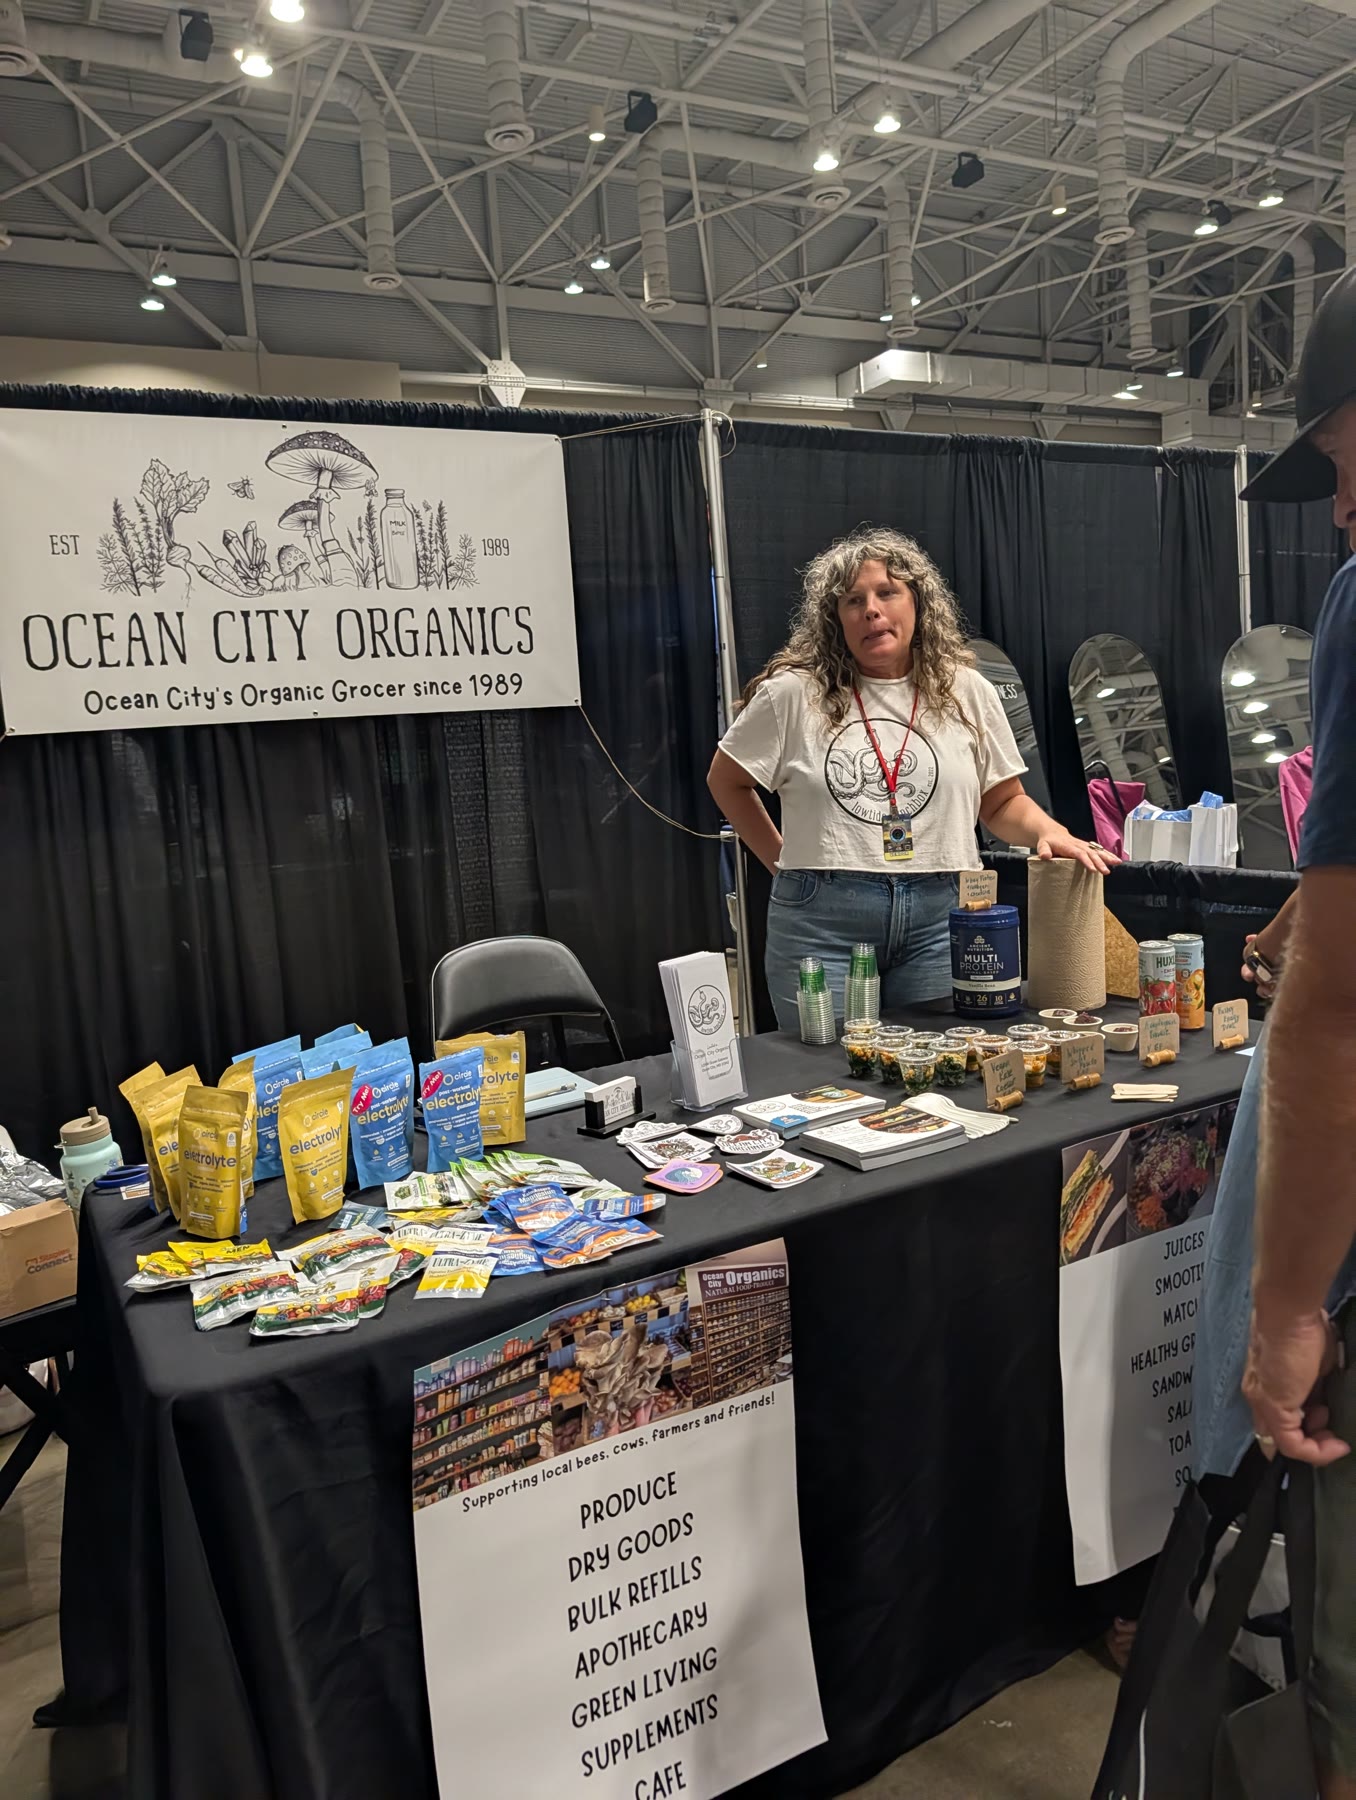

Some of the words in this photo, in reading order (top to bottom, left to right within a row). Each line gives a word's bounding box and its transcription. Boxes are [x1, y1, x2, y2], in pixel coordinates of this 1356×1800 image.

[50, 535, 80, 556] EST
[482, 538, 511, 557] 1989
[22, 611, 188, 671] OCEAN
[212, 609, 310, 664] CITY
[336, 606, 535, 660] ORGANICS
[84, 690, 159, 715] Ocean
[167, 685, 233, 710] City's
[241, 683, 325, 706] Organic
[331, 679, 406, 703] Grocer
[413, 680, 462, 698] since
[469, 672, 523, 697] 1989
[960, 962, 1004, 971] PROTEIN
[964, 953, 998, 963] MULTI
[976, 994, 988, 1002] 26
[273, 1077, 290, 1089] circle
[380, 1081, 399, 1093] circle
[454, 1070, 473, 1080] circle
[352, 1101, 364, 1113] Try
[361, 1085, 370, 1101] Me!
[1163, 1231, 1205, 1260] JUICES
[27, 1253, 74, 1274] Connect
[702, 1272, 725, 1282] Ocean
[725, 1267, 785, 1286] Organics
[705, 1286, 736, 1298] NATURAL
[707, 1280, 722, 1288] City
[1163, 1298, 1198, 1327] MATC
[1131, 1338, 1179, 1374] HEALTHY
[1152, 1365, 1193, 1398] SANDW
[462, 1474, 538, 1513] Supporting
[542, 1459, 572, 1482] local
[652, 1418, 700, 1442] farmers
[703, 1408, 724, 1426] and
[728, 1391, 775, 1417] friends!
[580, 1471, 677, 1530] PRODUCE
[568, 1543, 610, 1583] DRY
[617, 1512, 694, 1561] GOODS
[567, 1587, 622, 1632] BULK
[628, 1555, 702, 1607] REFILLS
[575, 1601, 708, 1679] APOTHECARY
[571, 1680, 636, 1728] GREEN
[643, 1646, 718, 1699] LIVING
[581, 1693, 718, 1778] SUPPLEMENTS
[635, 1761, 687, 1800] CAFE
